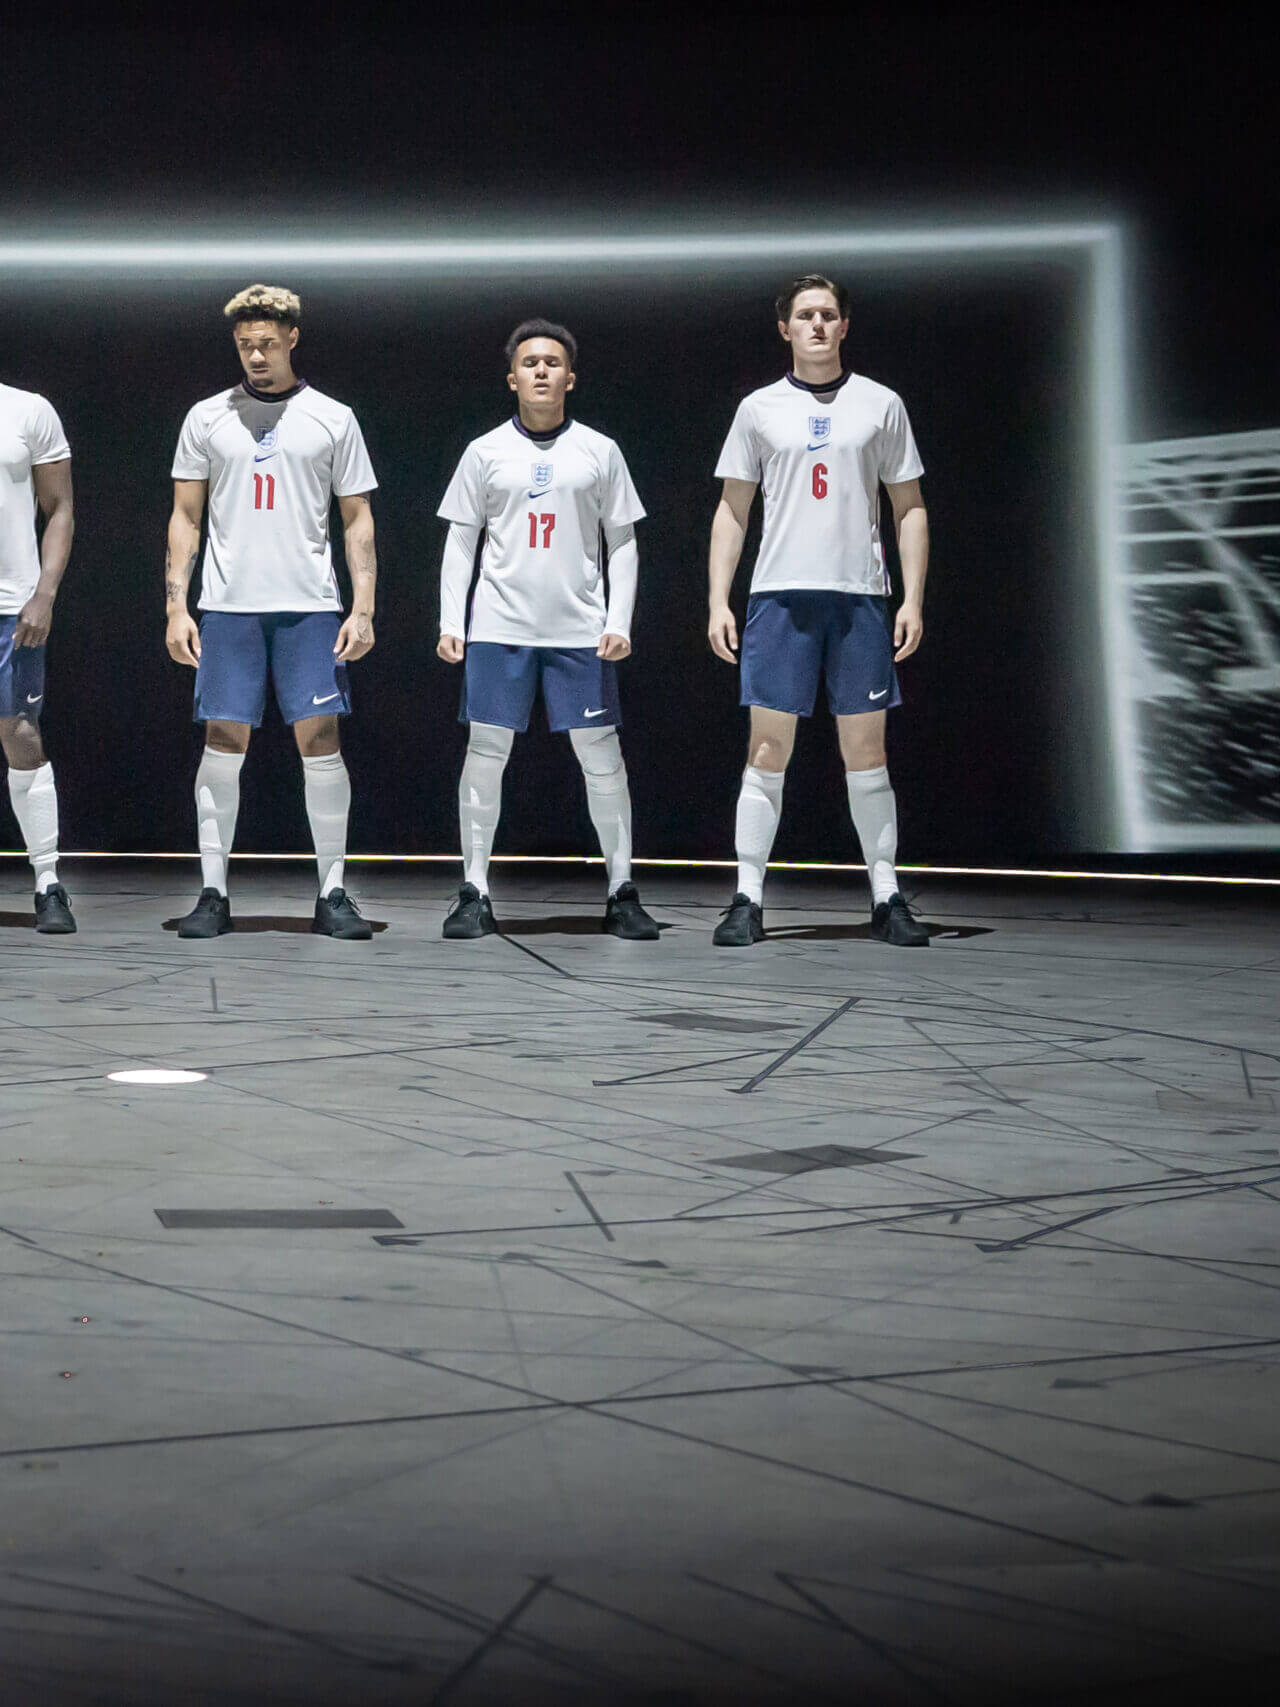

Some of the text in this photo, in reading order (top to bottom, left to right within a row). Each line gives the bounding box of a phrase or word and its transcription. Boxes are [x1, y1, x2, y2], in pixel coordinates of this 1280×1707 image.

[252, 473, 276, 509] 11
[812, 463, 828, 499] 6
[528, 513, 555, 548] 17
